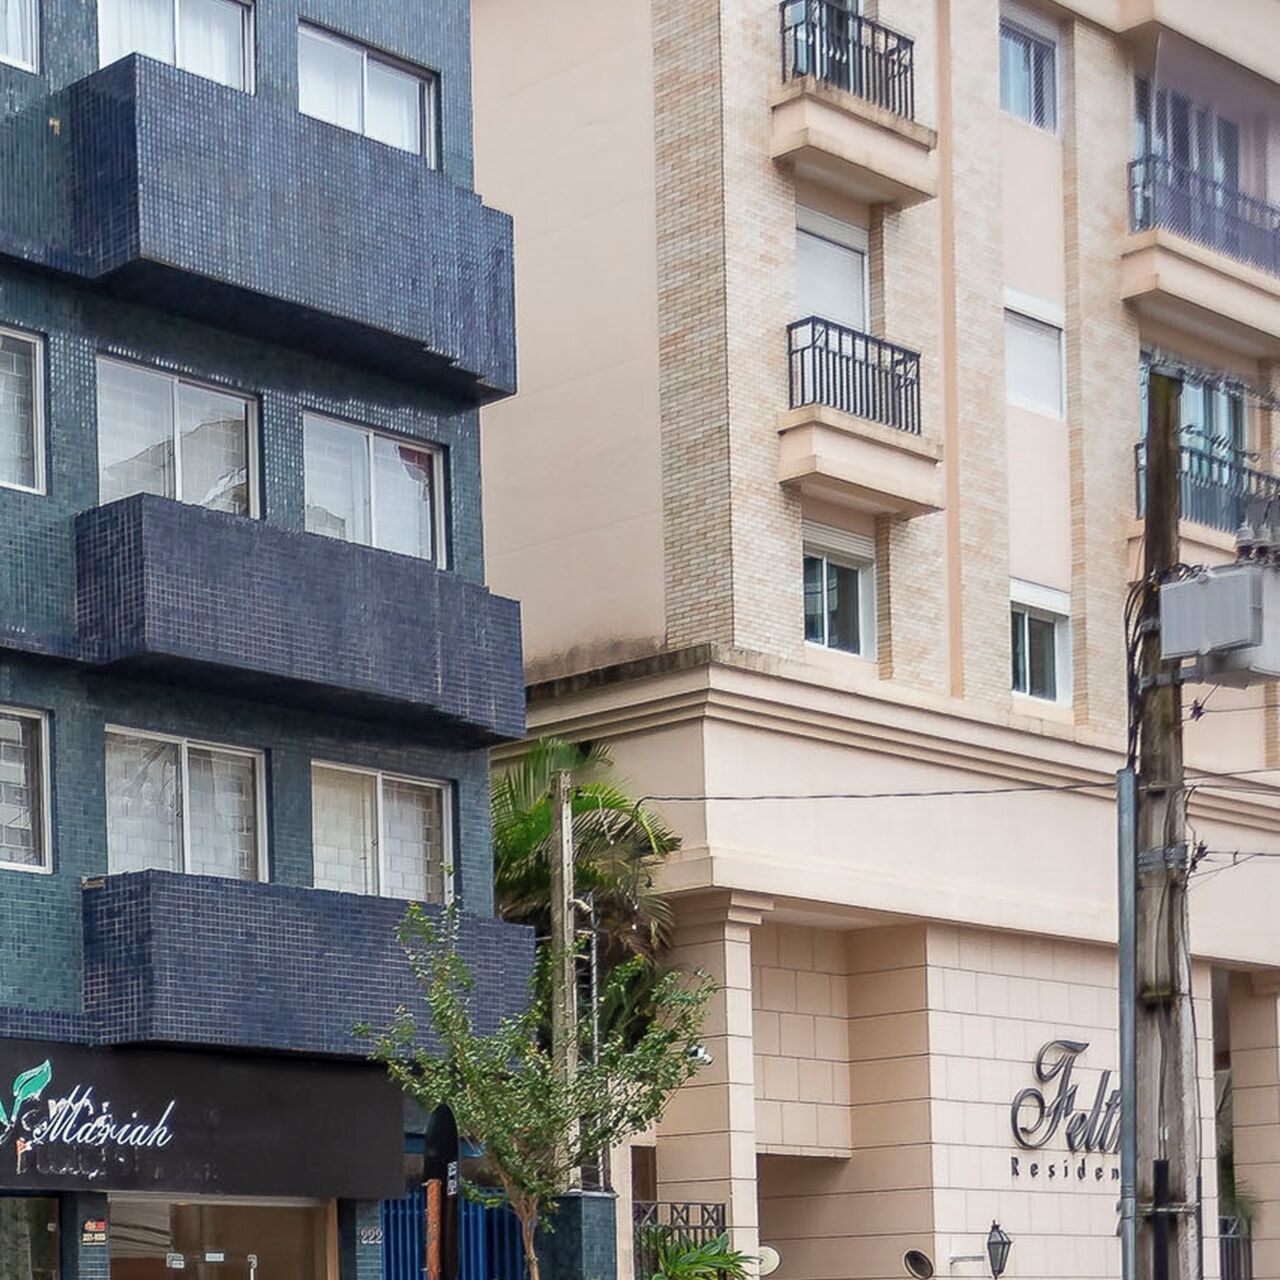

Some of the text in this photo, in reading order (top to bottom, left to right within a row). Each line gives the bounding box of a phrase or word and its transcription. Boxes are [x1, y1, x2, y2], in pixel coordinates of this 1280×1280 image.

[33, 1085, 175, 1148] Mariah
[1011, 1157, 1120, 1181] Residen
[361, 1228, 383, 1244] 222
